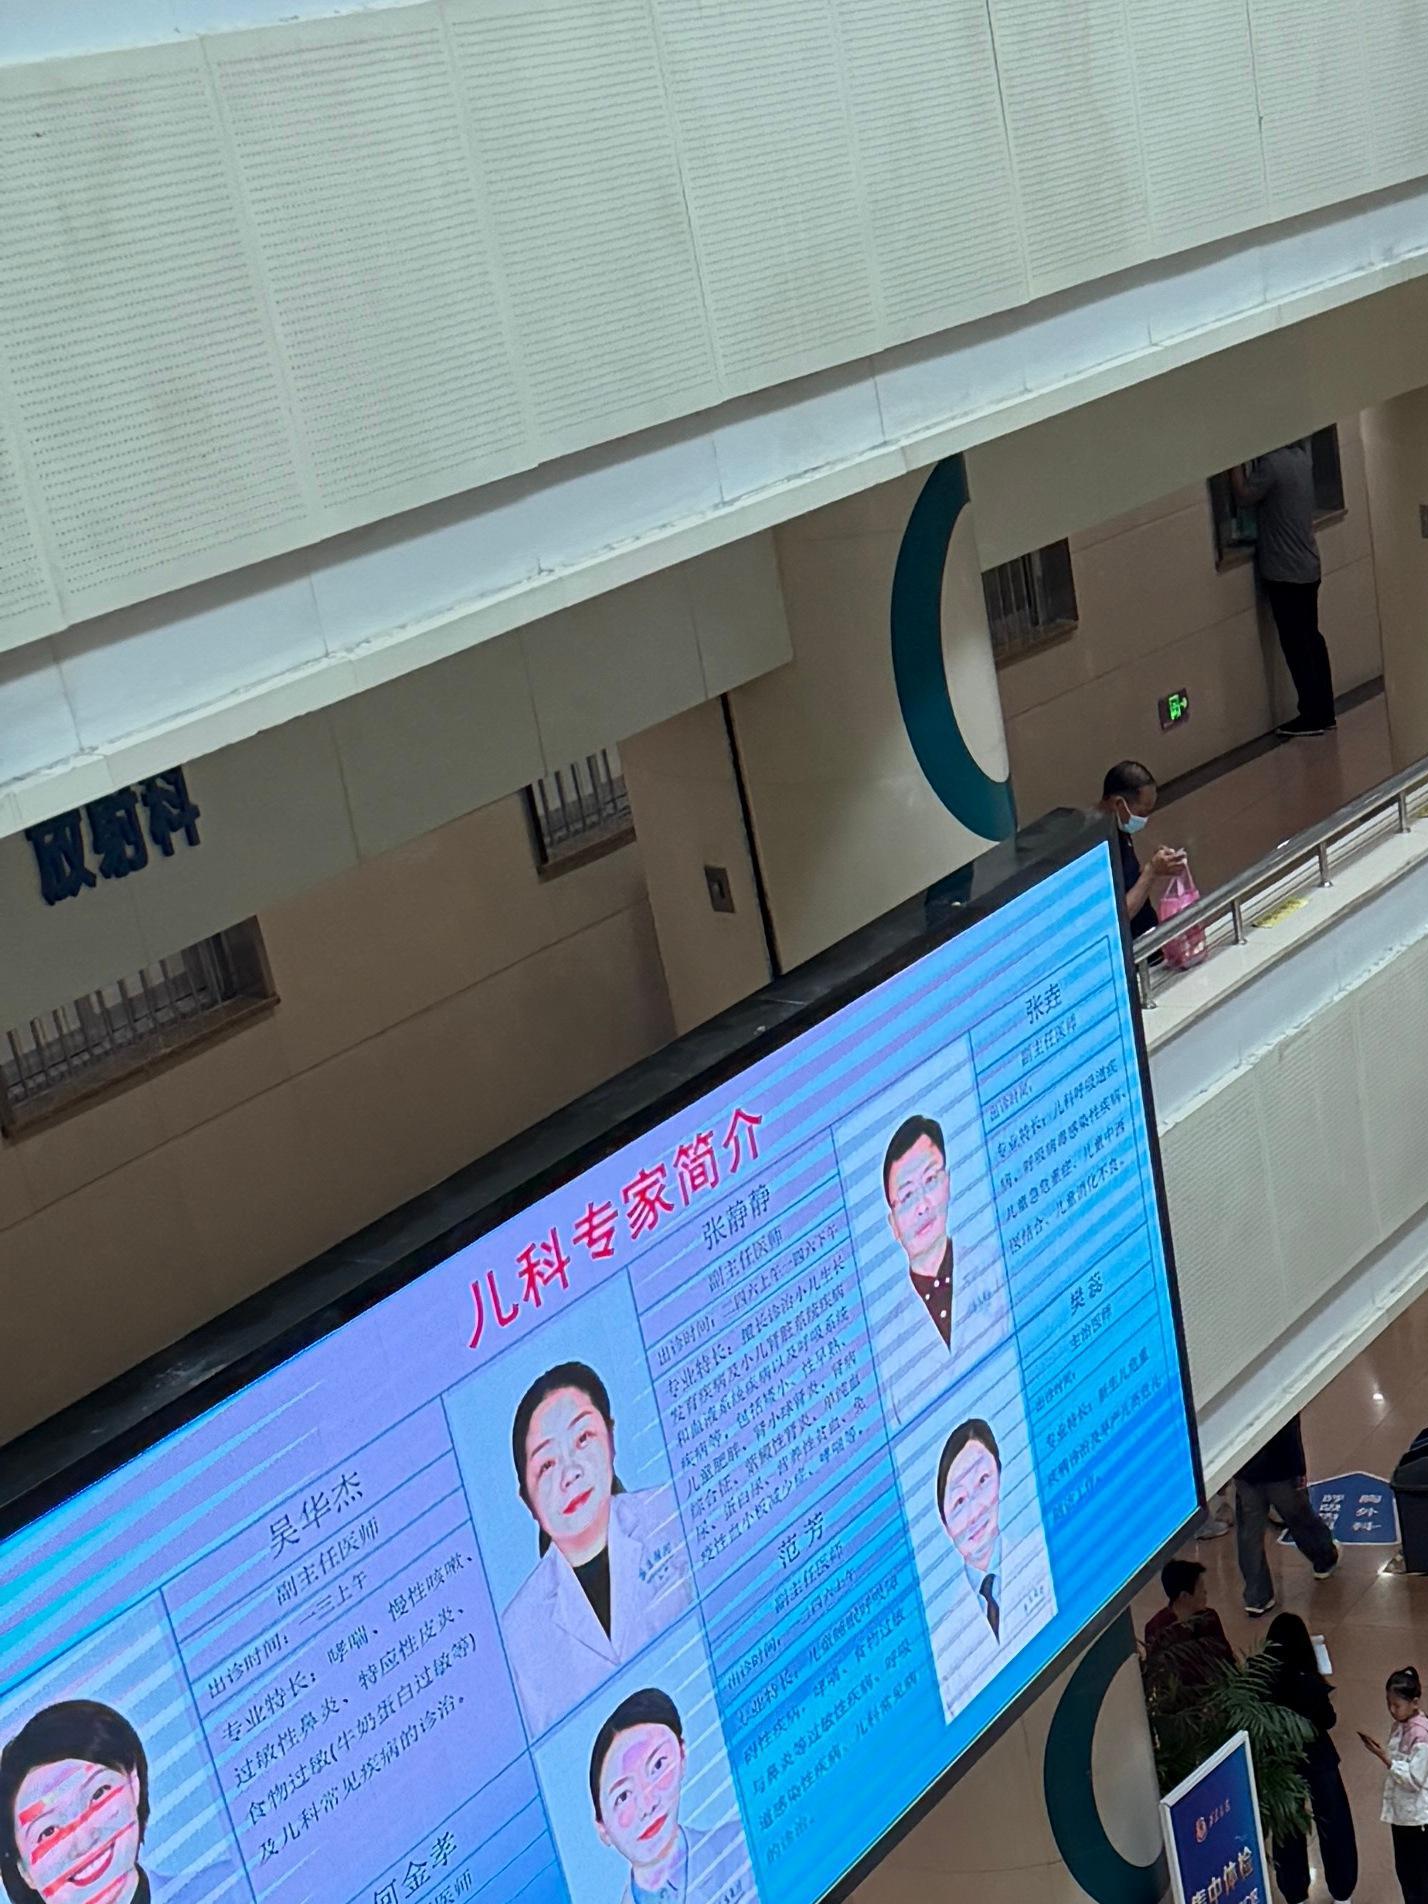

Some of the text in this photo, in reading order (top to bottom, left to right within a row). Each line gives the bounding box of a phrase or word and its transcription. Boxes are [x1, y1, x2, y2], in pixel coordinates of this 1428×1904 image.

[1020, 1012, 1077, 1067] 副主任医师
[453, 1095, 769, 1352] 儿科专家简介
[701, 1180, 772, 1253] 张静静
[706, 1223, 784, 1295] 副主任医师
[264, 1465, 364, 1559] 吴华杰
[273, 1514, 381, 1607] 副主任医师
[773, 1539, 844, 1615] 副主任医师
[206, 1567, 370, 1700] 出诊时间：一三上午
[231, 1593, 467, 1789] 过敏性鼻炎、特应性皮炎、
[256, 1683, 466, 1866] 及儿科常见疾病的诊治。
